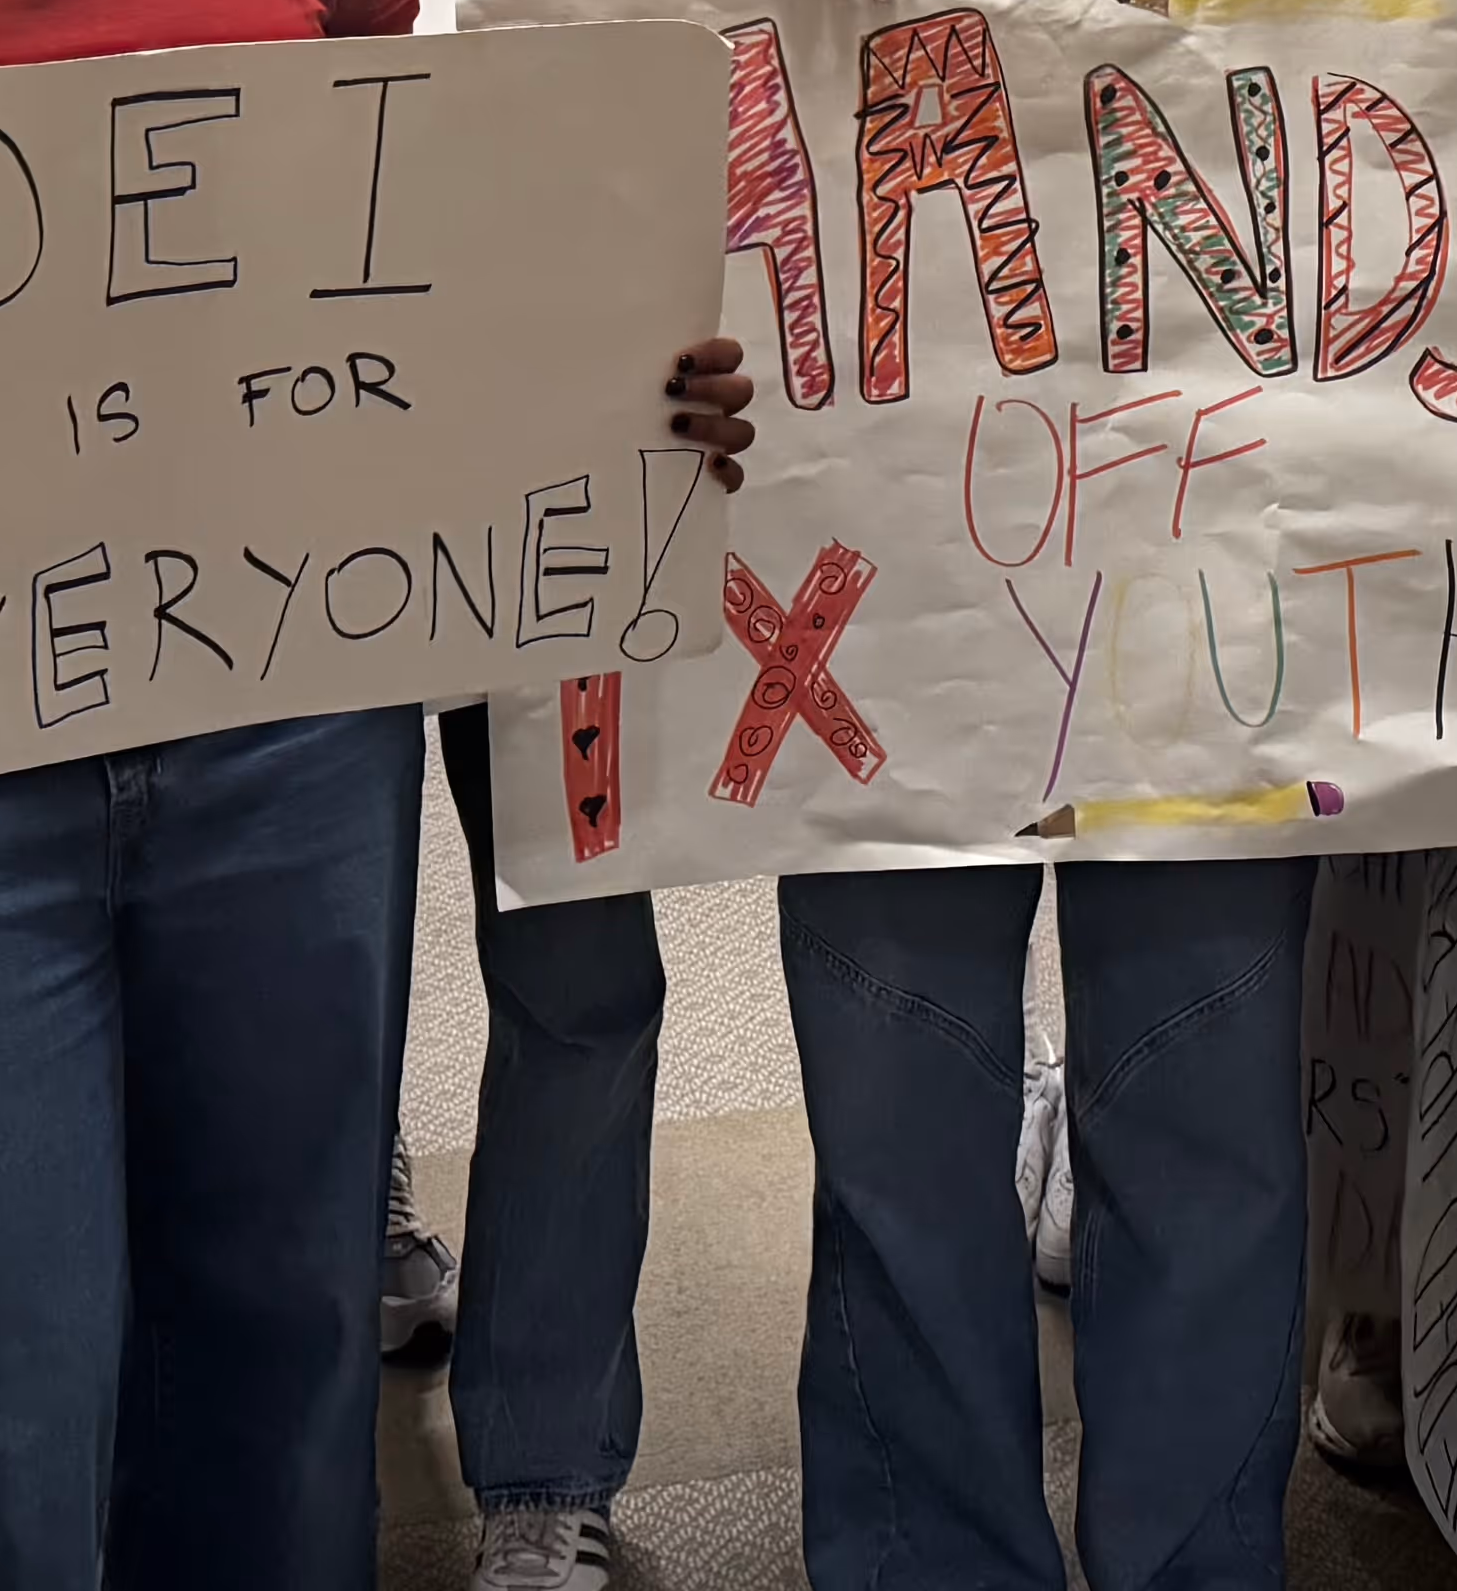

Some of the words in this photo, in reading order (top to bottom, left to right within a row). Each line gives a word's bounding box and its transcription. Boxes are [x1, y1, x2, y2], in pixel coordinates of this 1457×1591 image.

[69, 383, 141, 455] IS
[237, 351, 412, 429] FOR
[963, 384, 1269, 568] OFF
